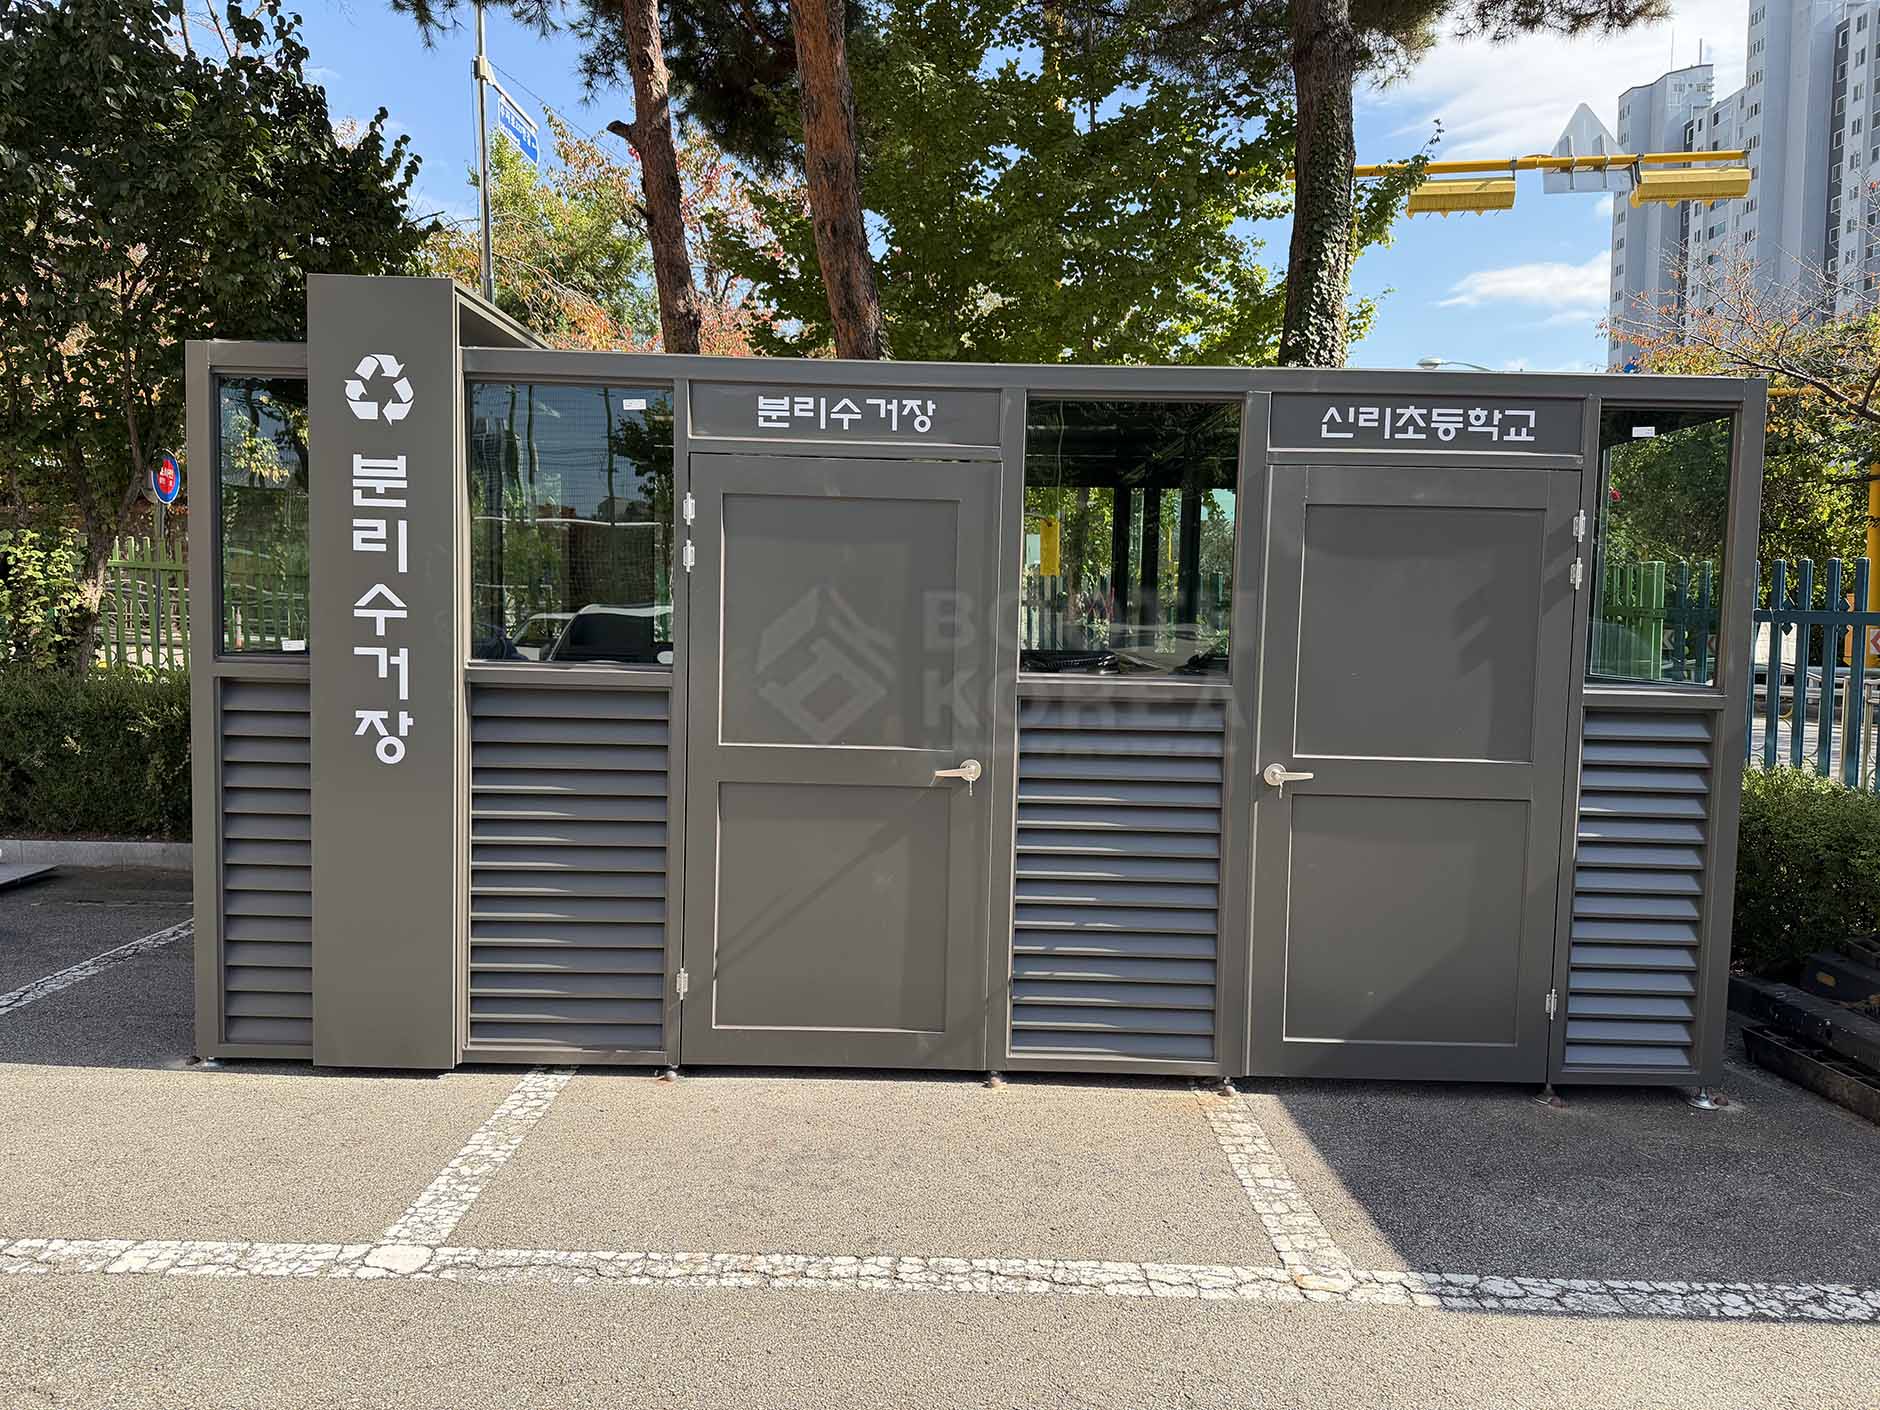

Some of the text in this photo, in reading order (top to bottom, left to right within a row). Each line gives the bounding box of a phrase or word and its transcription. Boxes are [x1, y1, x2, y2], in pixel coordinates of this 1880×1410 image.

[757, 395, 937, 434] 분리수거장
[1320, 404, 1537, 442] 신리초등학교
[351, 452, 415, 766] 분리수거장
